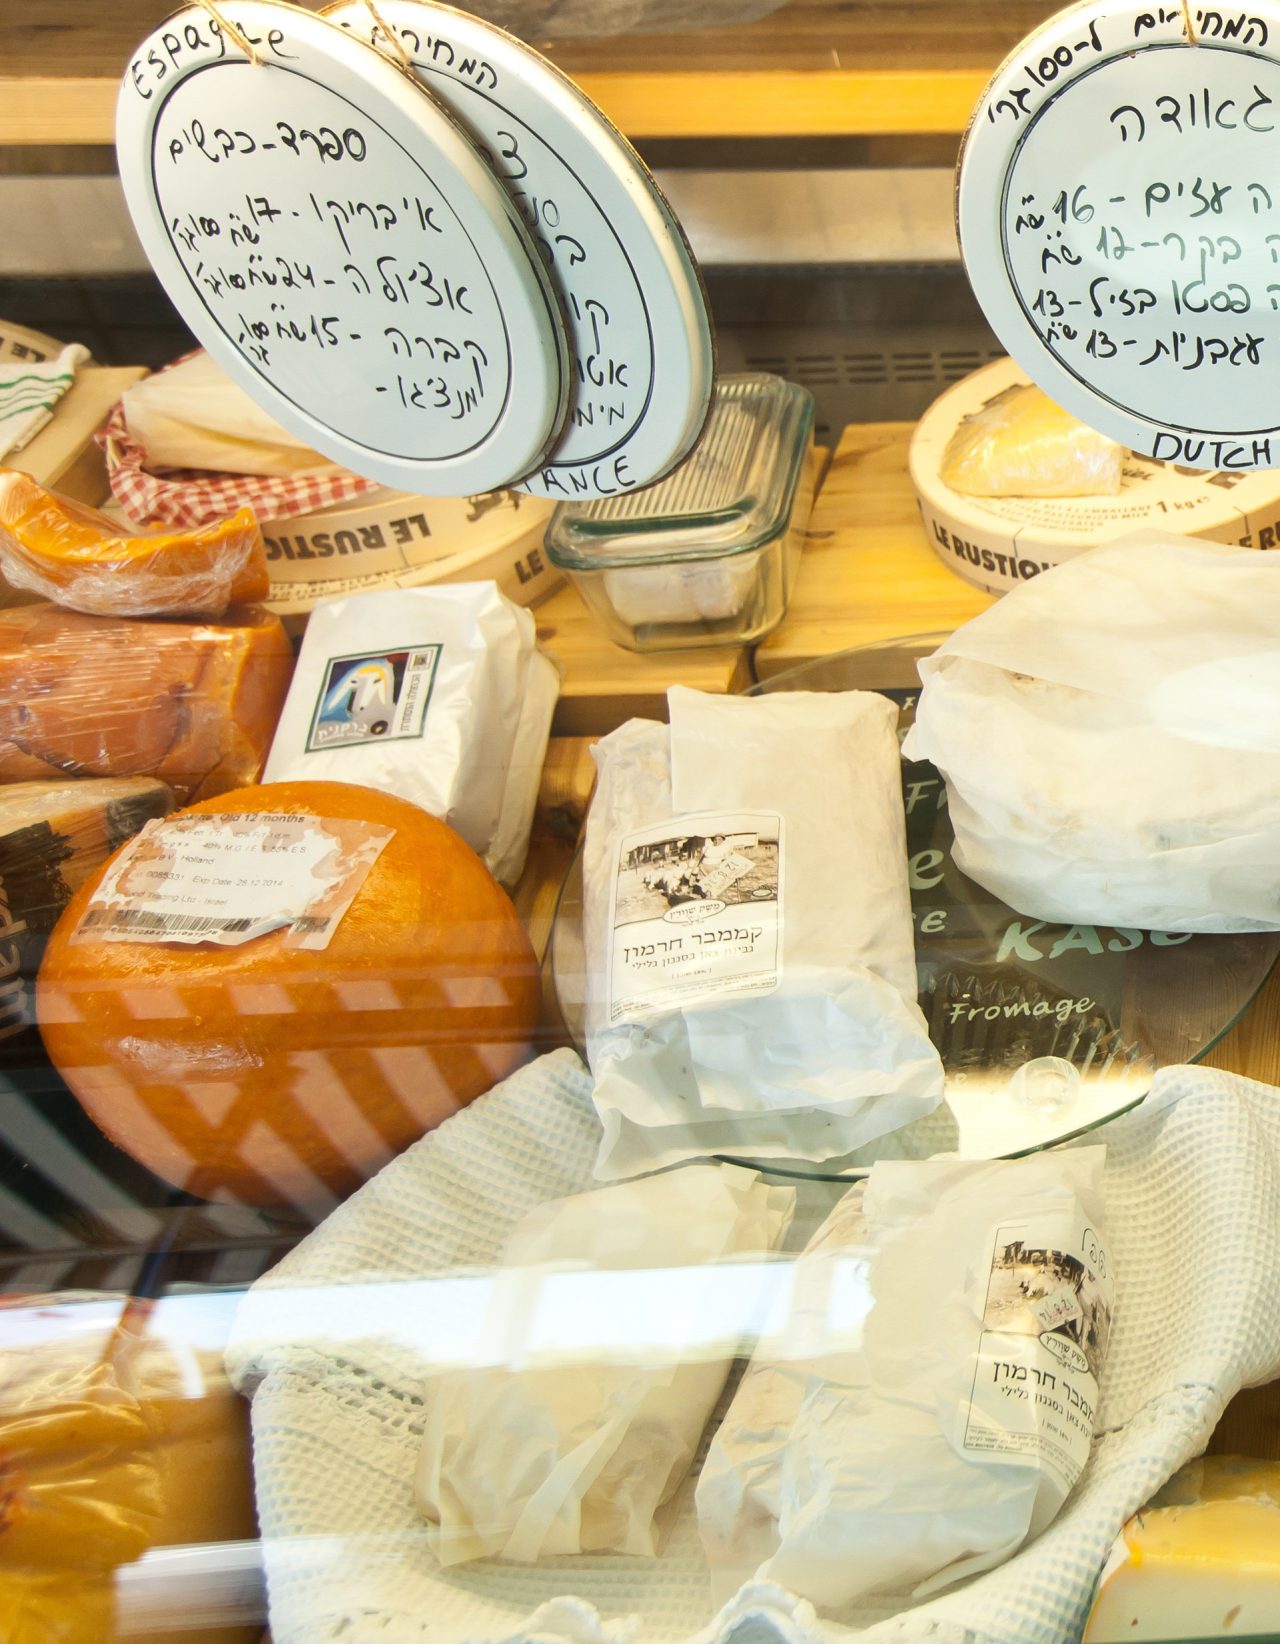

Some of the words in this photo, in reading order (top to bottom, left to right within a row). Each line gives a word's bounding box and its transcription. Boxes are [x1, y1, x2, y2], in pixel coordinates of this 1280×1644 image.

[1109, 85, 1276, 143] גאודה
[245, 194, 282, 225] 17
[1052, 184, 1095, 224] 16
[1144, 176, 1233, 217] עזים
[1152, 431, 1272, 468] DUTCH
[388, 513, 432, 543] LE
[932, 519, 951, 551] LE
[244, 814, 257, 823] 12
[262, 815, 305, 824] months
[624, 938, 683, 963] חרמון
[691, 926, 763, 945] קממבר
[950, 997, 1096, 1025] Fromage
[993, 1361, 1057, 1390] חרמון
